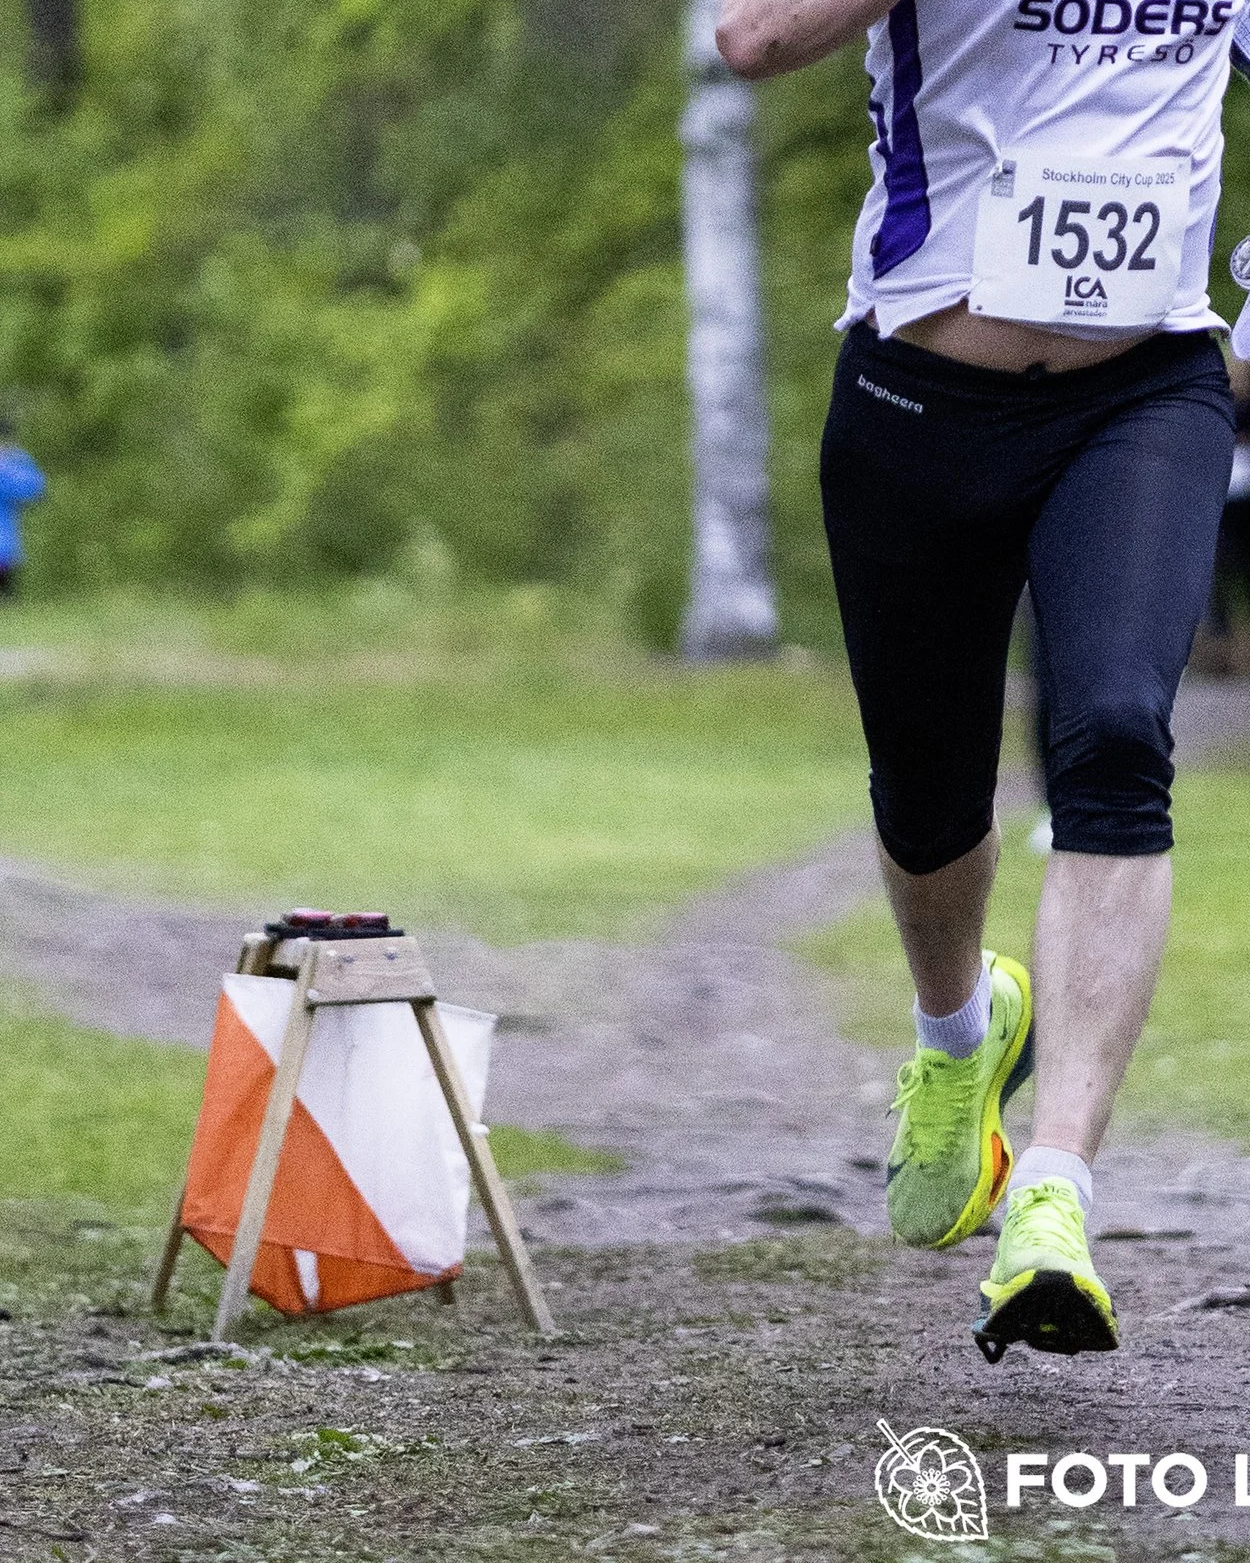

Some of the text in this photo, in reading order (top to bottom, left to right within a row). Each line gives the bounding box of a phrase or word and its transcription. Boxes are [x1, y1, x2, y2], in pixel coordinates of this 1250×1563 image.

[1047, 38, 1195, 66] TYRESÖ
[1042, 167, 1175, 188] Stockholm City Cup 2025
[1017, 195, 1160, 272] 1532
[1065, 275, 1108, 299] ICA
[857, 373, 924, 414] bagheera
